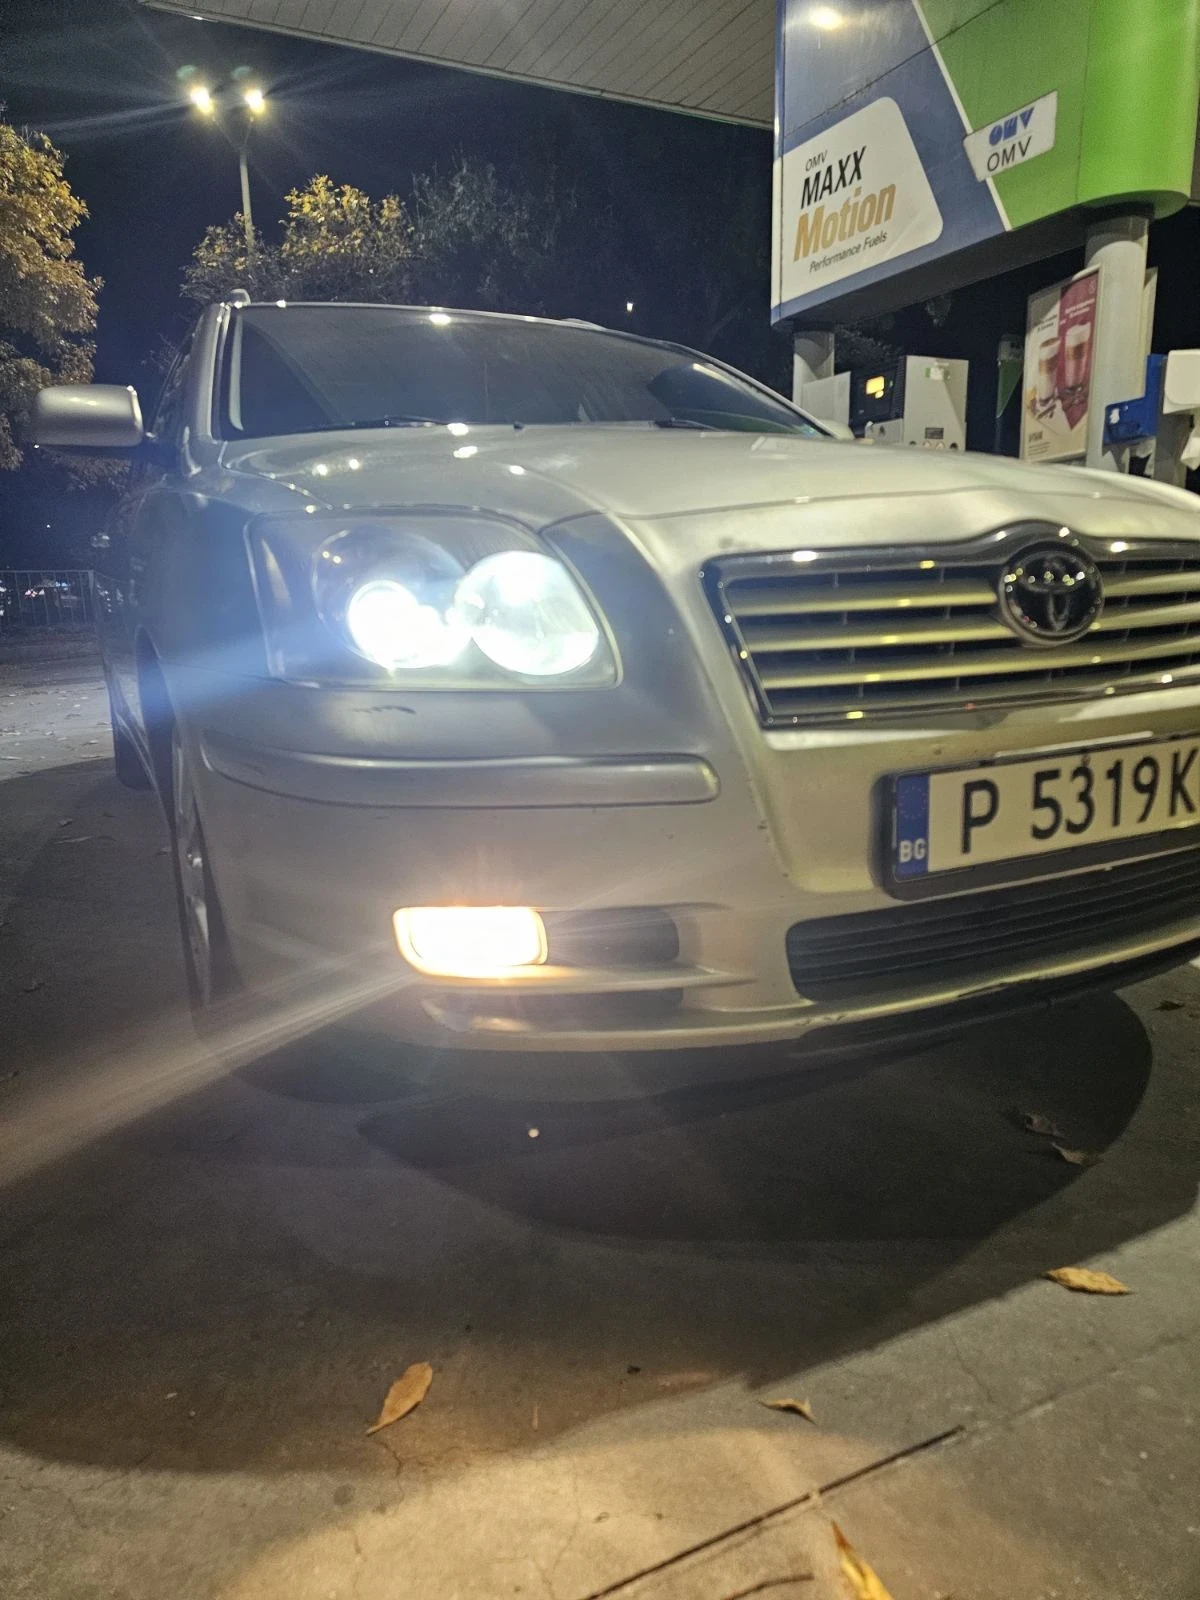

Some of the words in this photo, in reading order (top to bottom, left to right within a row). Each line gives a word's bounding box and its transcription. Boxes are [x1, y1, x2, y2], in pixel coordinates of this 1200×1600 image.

[806, 151, 827, 171] OMV
[987, 135, 1031, 172] OMV
[801, 146, 866, 209] MAXX
[793, 183, 897, 262] Motion
[809, 245, 862, 273] Performance
[862, 230, 887, 251] Fuels
[962, 779, 999, 854] P
[900, 839, 925, 863] BG
